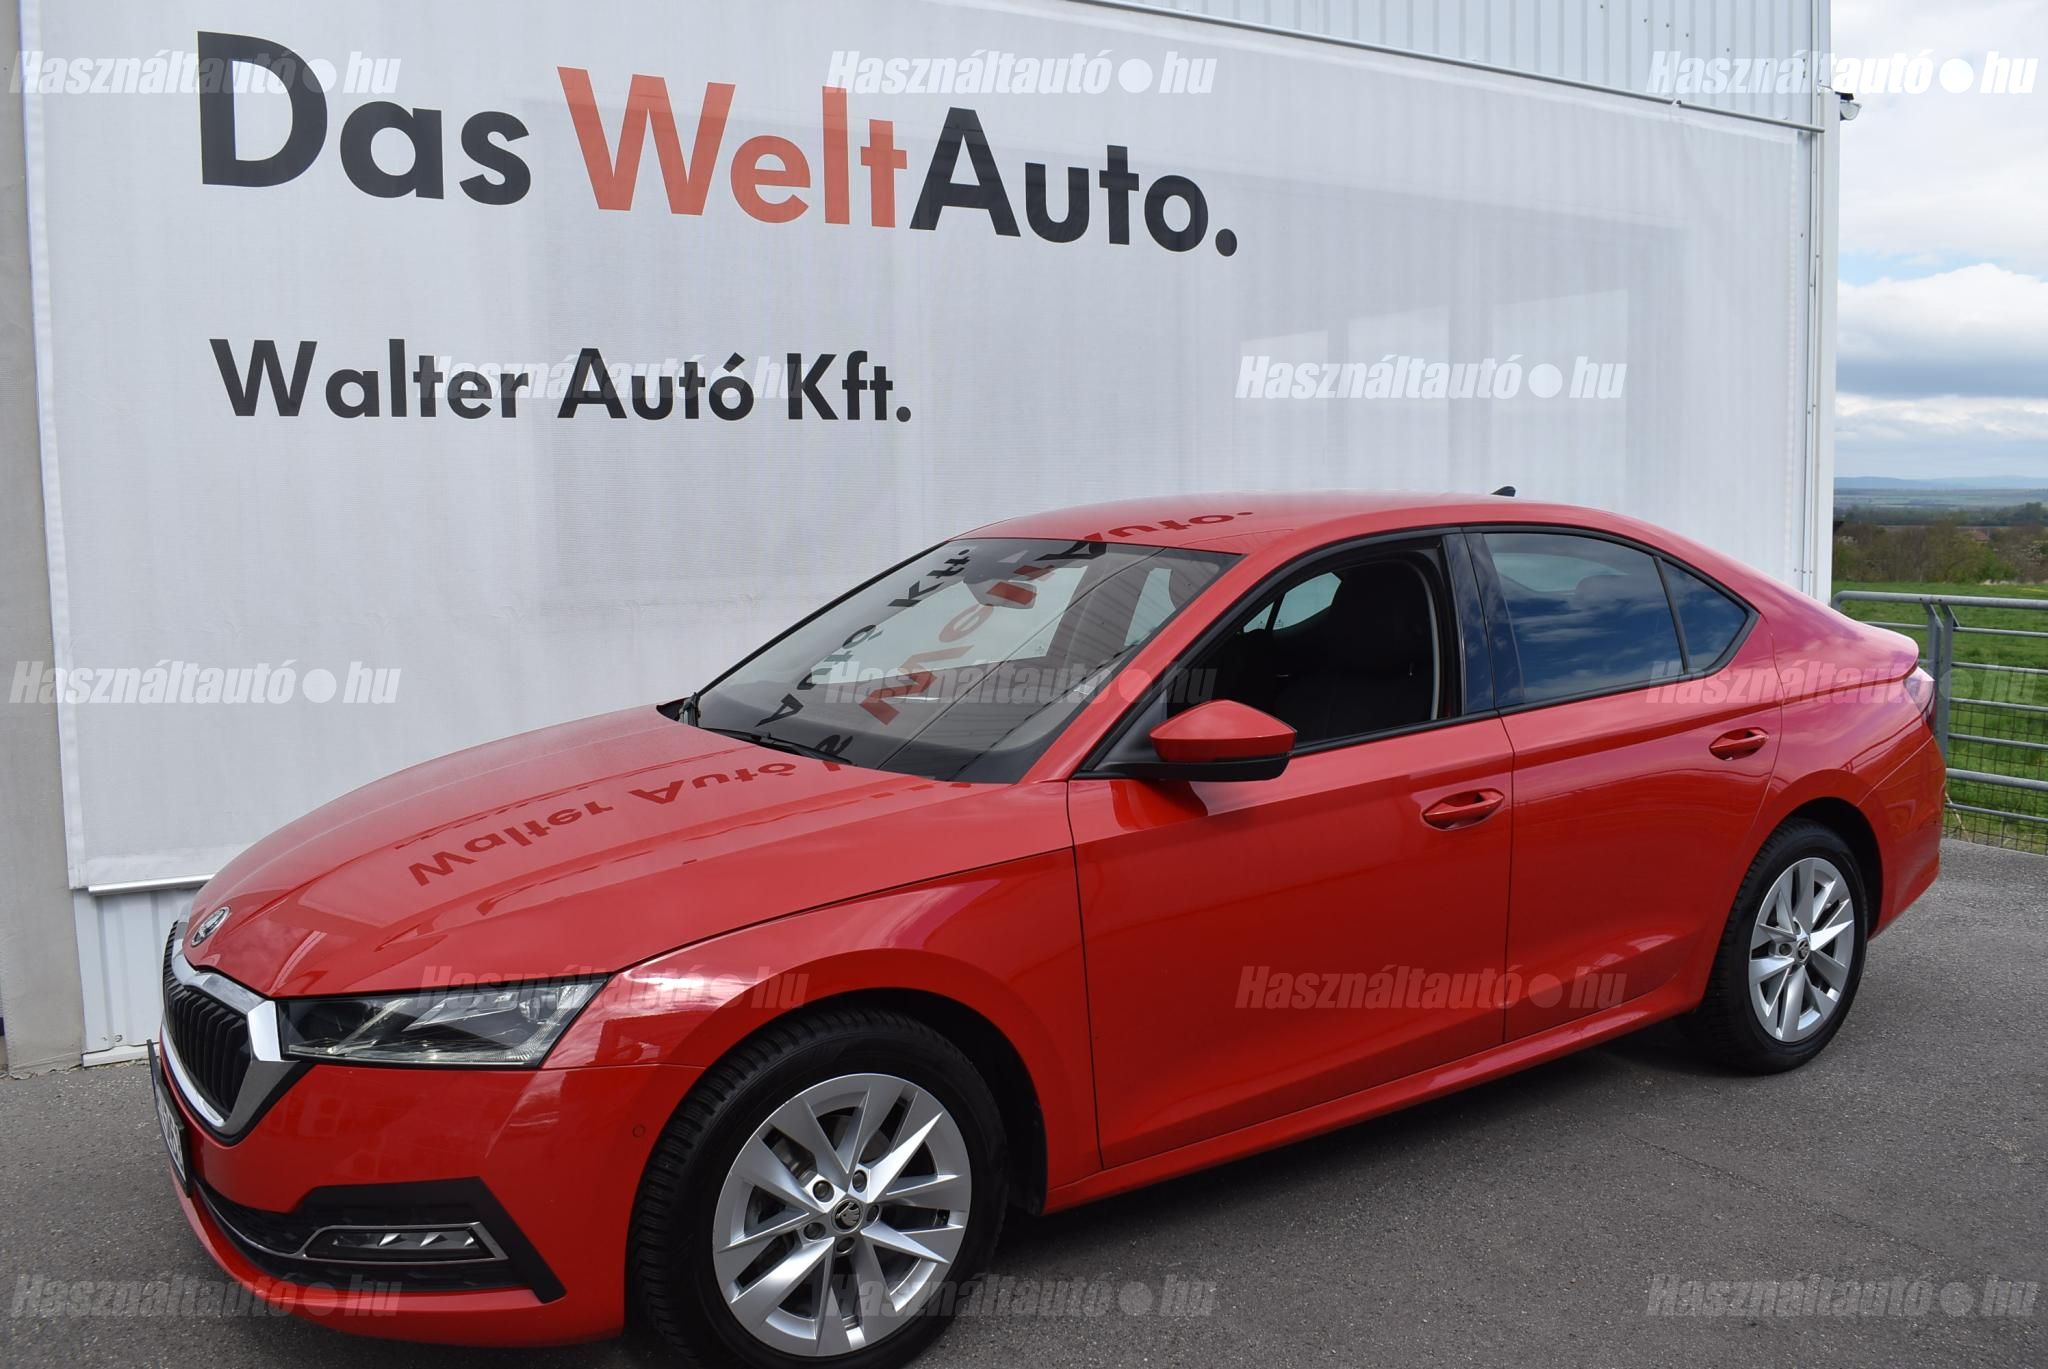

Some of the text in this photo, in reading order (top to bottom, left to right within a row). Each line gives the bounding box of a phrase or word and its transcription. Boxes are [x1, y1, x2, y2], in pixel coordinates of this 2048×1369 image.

[198, 30, 531, 206] Das
[210, 338, 911, 423] Walter Autó Kft.
